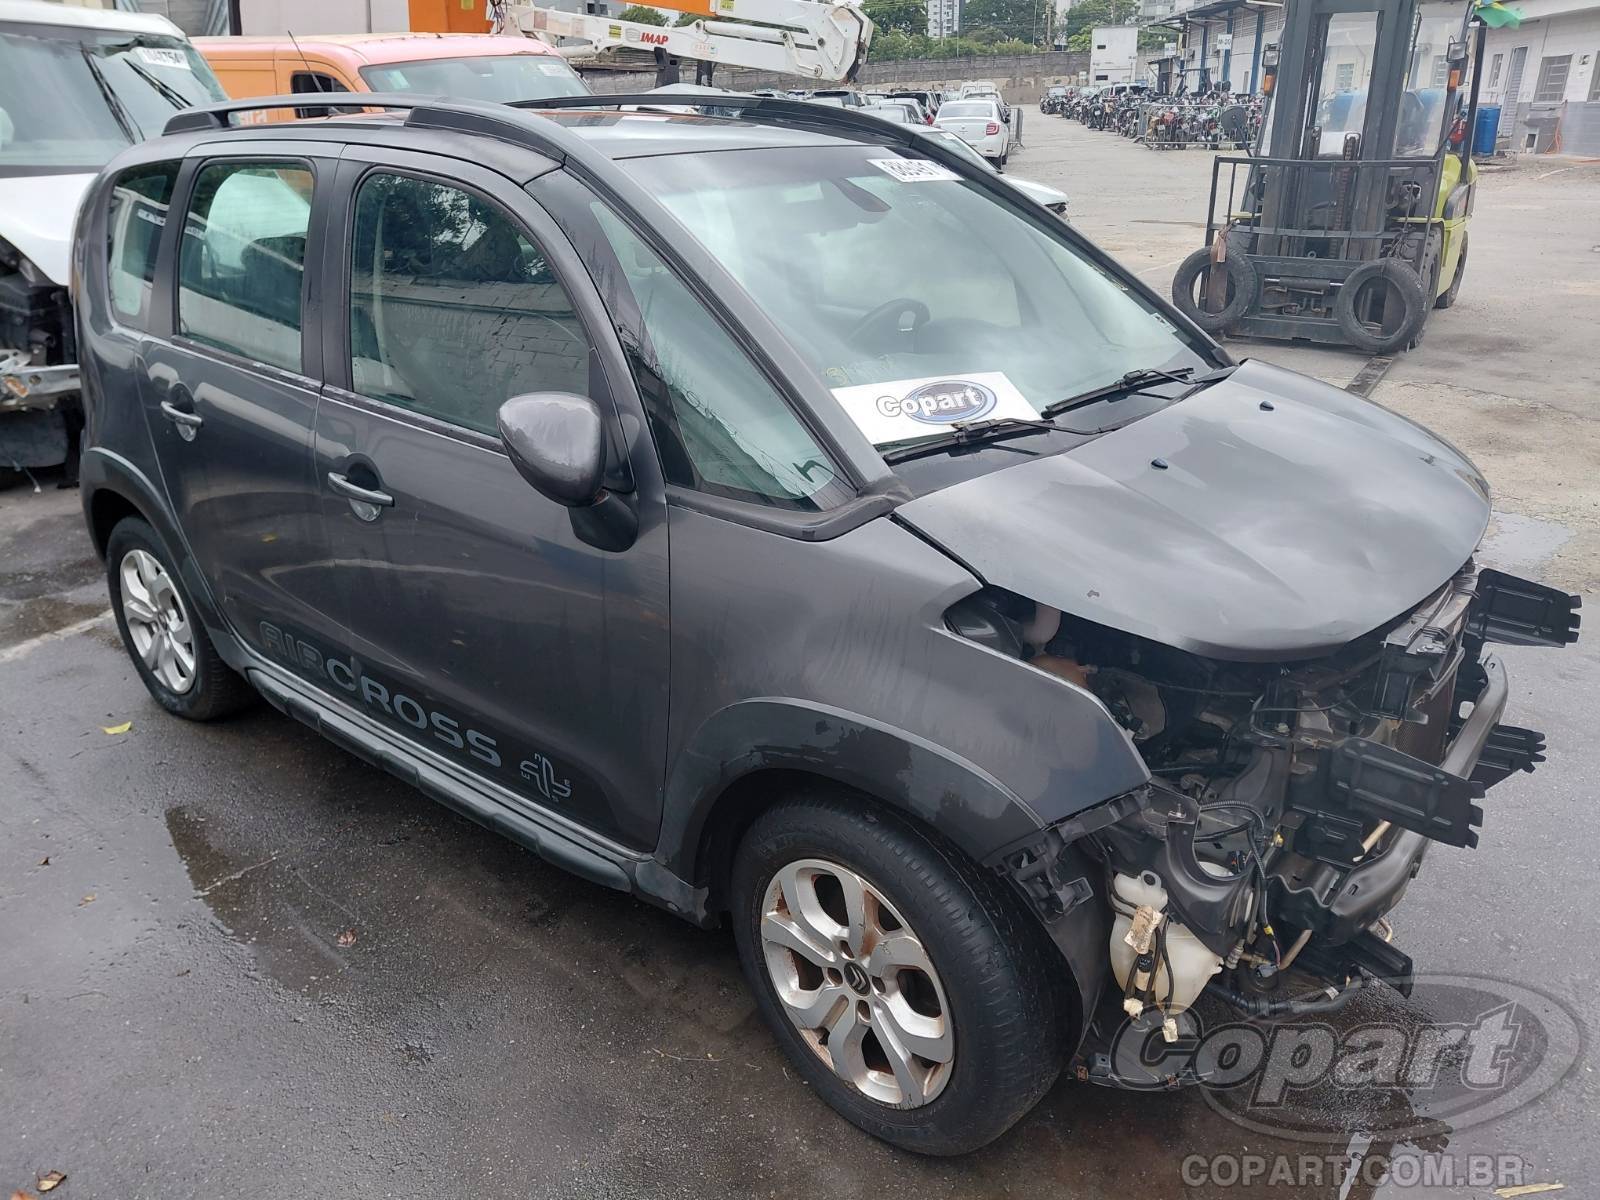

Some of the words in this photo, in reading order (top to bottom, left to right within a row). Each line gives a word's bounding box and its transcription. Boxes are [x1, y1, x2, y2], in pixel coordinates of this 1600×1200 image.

[640, 32, 669, 45] IMAP
[876, 385, 982, 418] Copart
[259, 620, 502, 768] AIRCROSS
